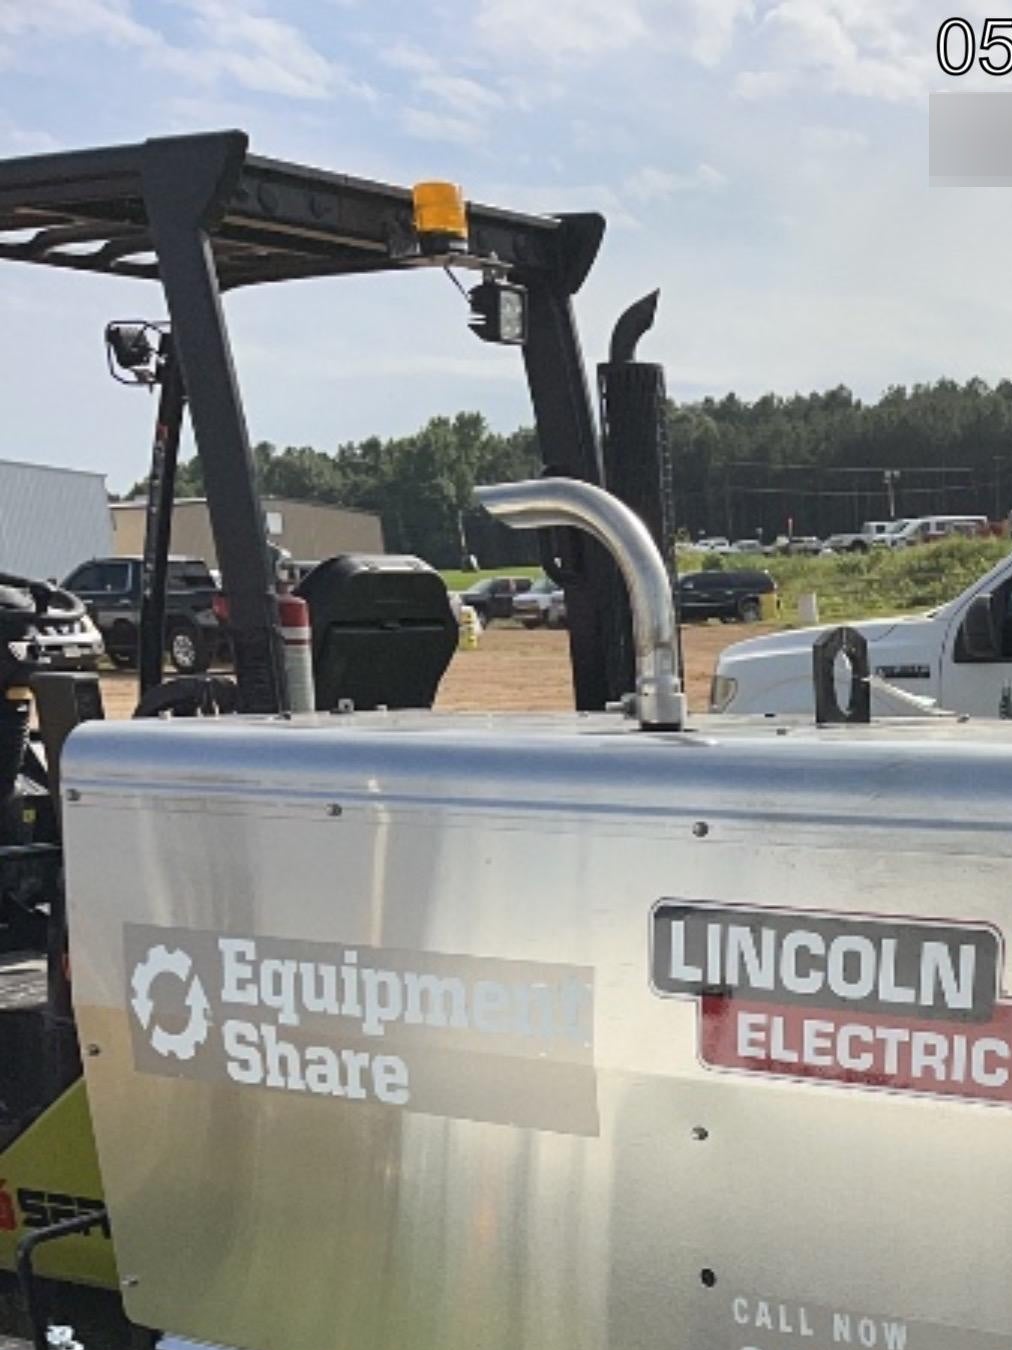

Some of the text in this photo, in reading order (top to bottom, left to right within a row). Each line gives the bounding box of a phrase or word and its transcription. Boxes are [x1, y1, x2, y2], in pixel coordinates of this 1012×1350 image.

[217, 936, 590, 1041] Equipment
[669, 919, 977, 1010] LINCOLN
[221, 1019, 412, 1105] Share
[736, 1010, 1012, 1088] ELECTRIC
[731, 1296, 814, 1338] CALL
